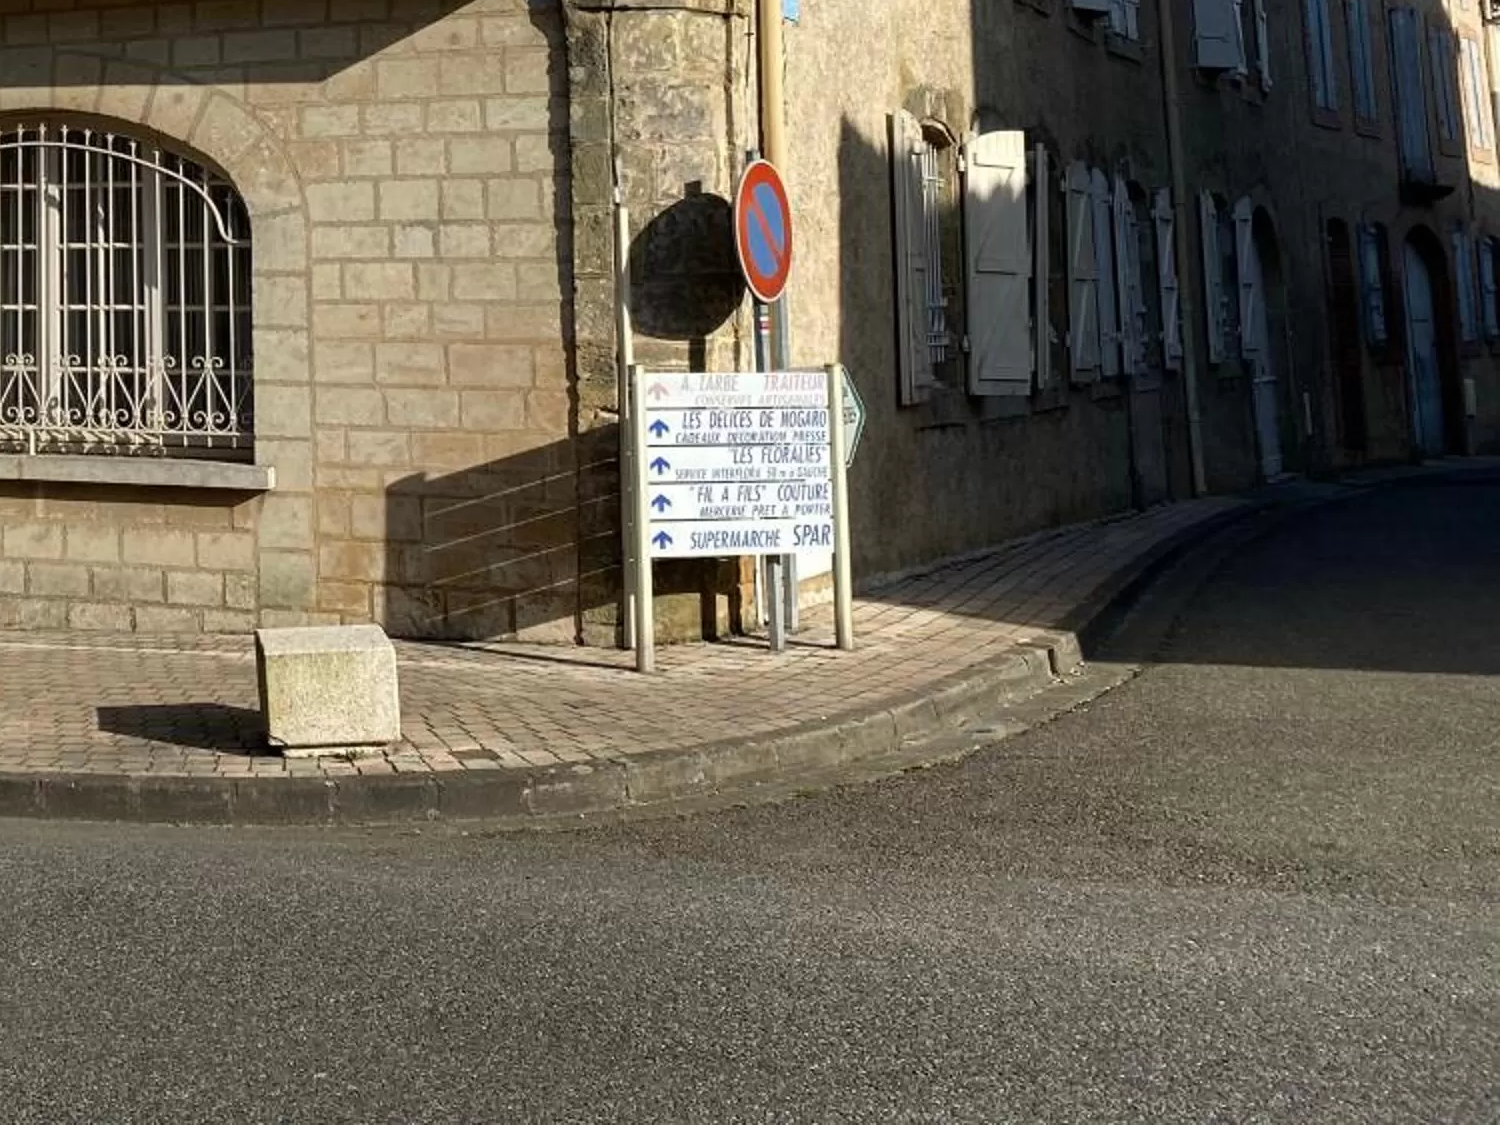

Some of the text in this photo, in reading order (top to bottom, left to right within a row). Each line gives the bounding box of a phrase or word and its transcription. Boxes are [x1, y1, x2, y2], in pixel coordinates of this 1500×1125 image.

[764, 374, 823, 391] TRAITEUR
[682, 411, 701, 429] LES
[759, 411, 775, 428] DE
[675, 432, 721, 443] CADEAUX
[793, 431, 827, 442] PRESSE
[721, 485, 729, 502] A
[777, 483, 828, 501] COUTURE
[700, 505, 747, 516] MERCERIE
[795, 503, 830, 514] PORTER
[690, 525, 831, 550] SUPERMARCHE SPAR
